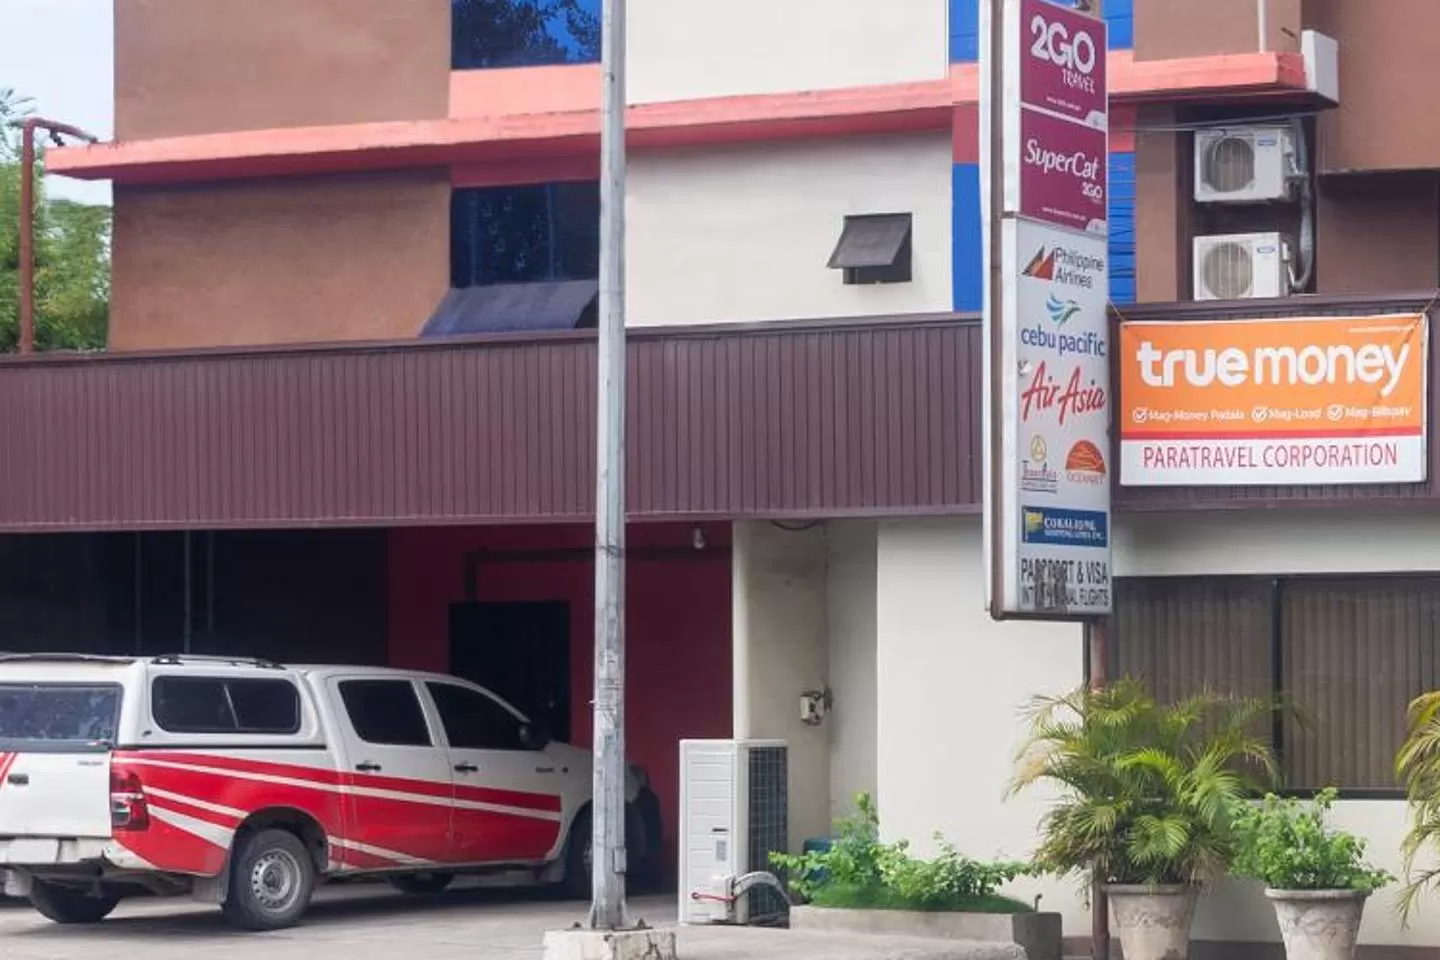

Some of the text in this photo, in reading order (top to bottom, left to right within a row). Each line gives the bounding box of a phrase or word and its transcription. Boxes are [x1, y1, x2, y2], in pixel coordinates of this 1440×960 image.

[1031, 14, 1096, 74] 2GO
[1062, 68, 1095, 95] TRAVEL
[1024, 138, 1099, 181] SuperCat
[1082, 181, 1103, 199] 2GO
[1054, 246, 1104, 273] Philippine
[1054, 268, 1094, 289] Airlines
[1021, 324, 1105, 356] cebu pacific
[1143, 443, 1397, 468] PARATRAVEL CORPORATION
[1077, 560, 1084, 584] &
[1086, 560, 1108, 585] VISA
